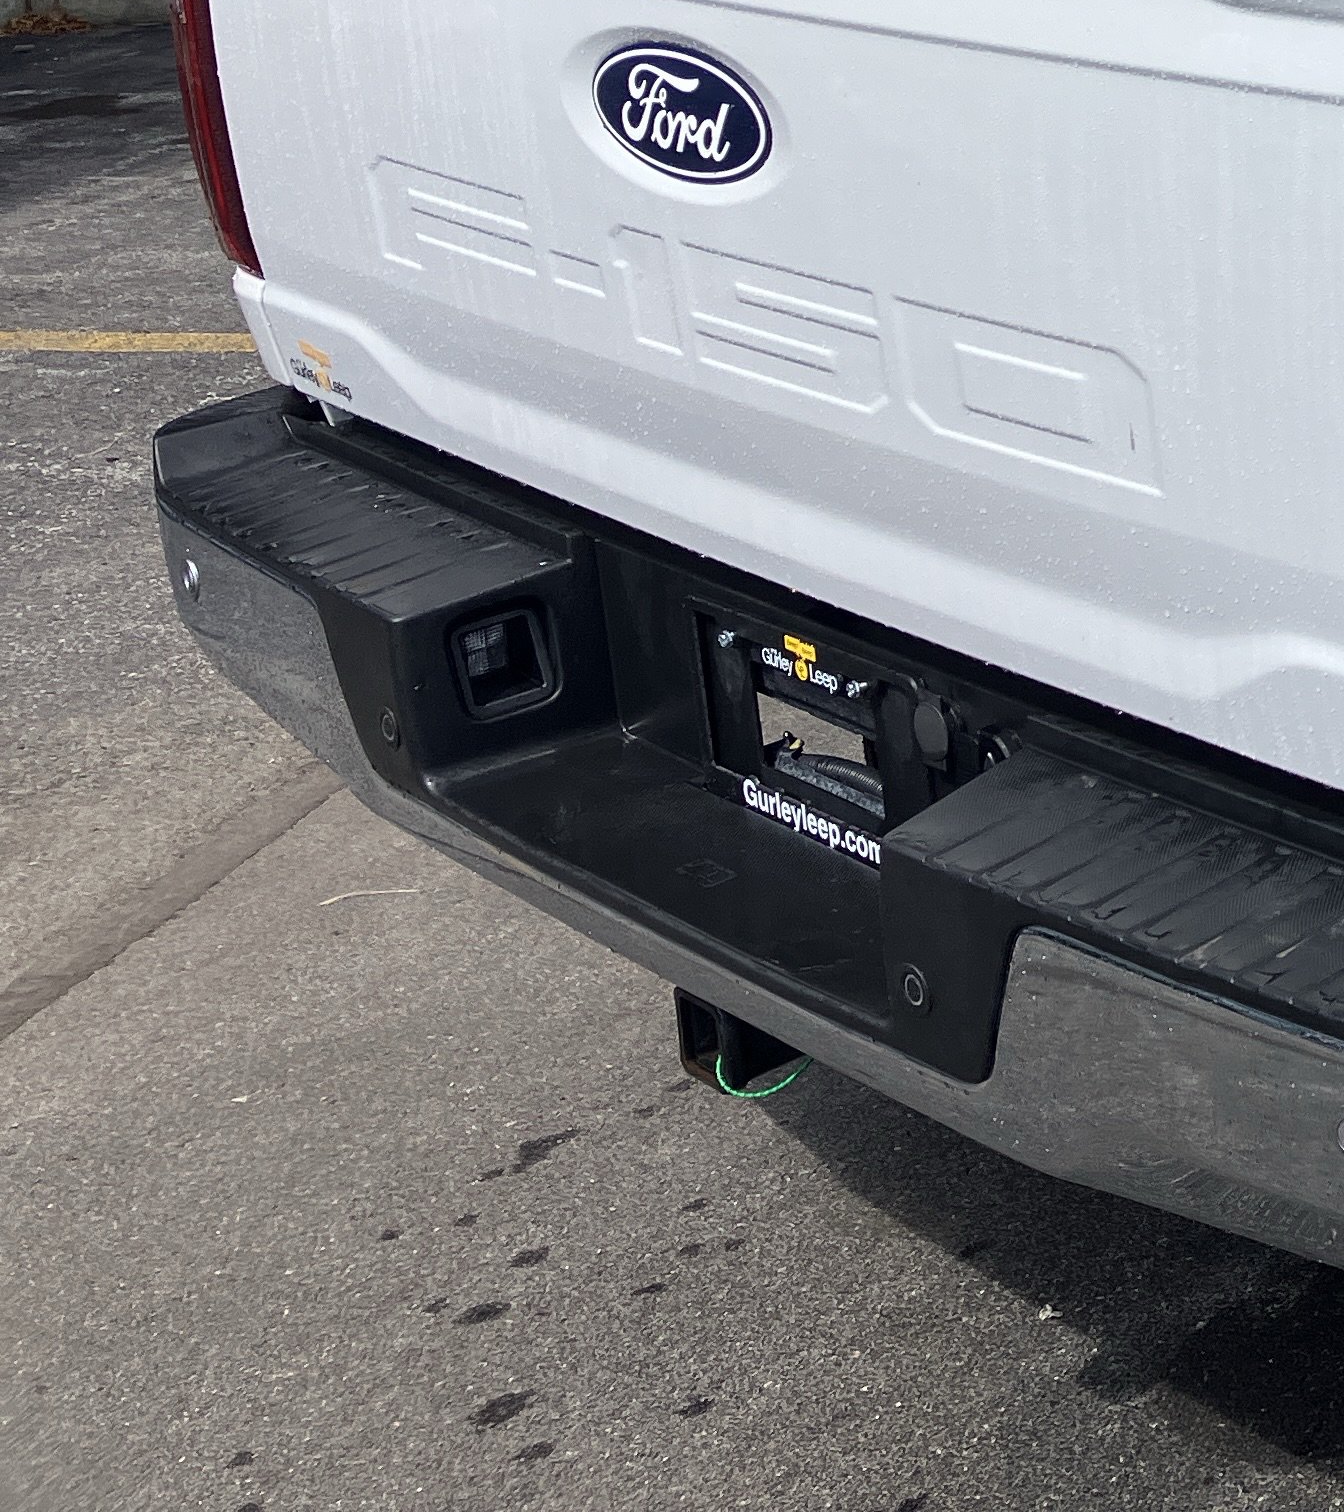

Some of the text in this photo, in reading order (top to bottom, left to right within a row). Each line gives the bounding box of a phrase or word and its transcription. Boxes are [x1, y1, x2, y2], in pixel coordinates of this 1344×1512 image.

[621, 61, 732, 165] Ford
[368, 154, 1166, 498] F-150
[808, 663, 838, 695] Leep
[742, 778, 881, 865] Gurleyleep.com
